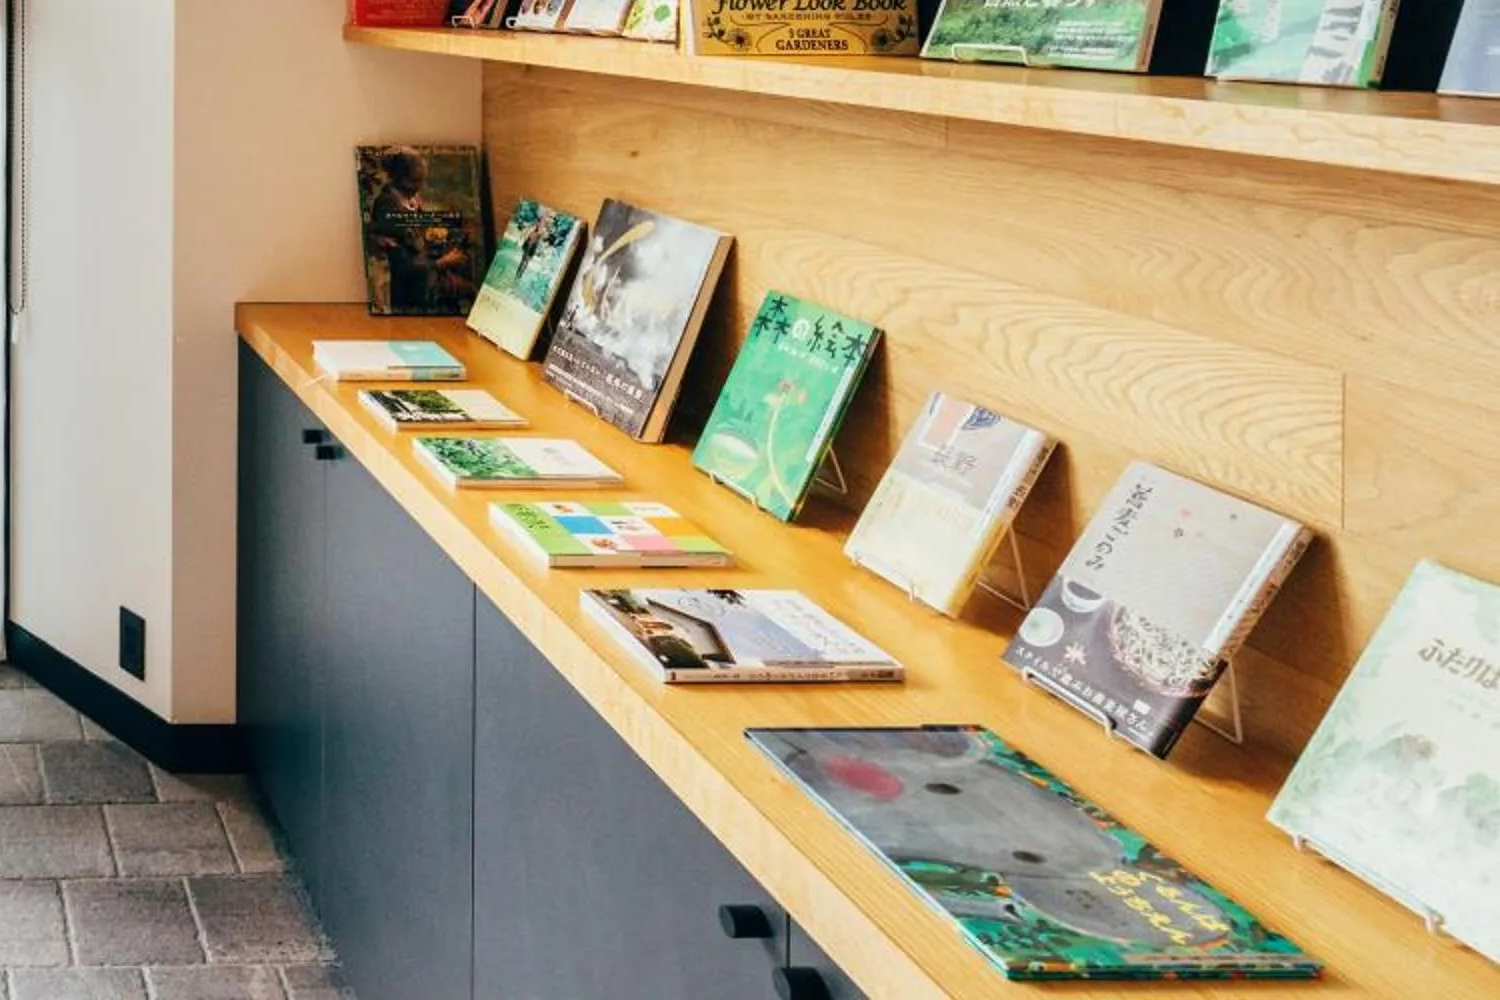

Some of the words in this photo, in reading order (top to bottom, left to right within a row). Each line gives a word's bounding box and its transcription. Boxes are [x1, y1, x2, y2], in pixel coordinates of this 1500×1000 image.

[774, 39, 849, 51] GARDENERS
[753, 295, 865, 369] 森の絵本
